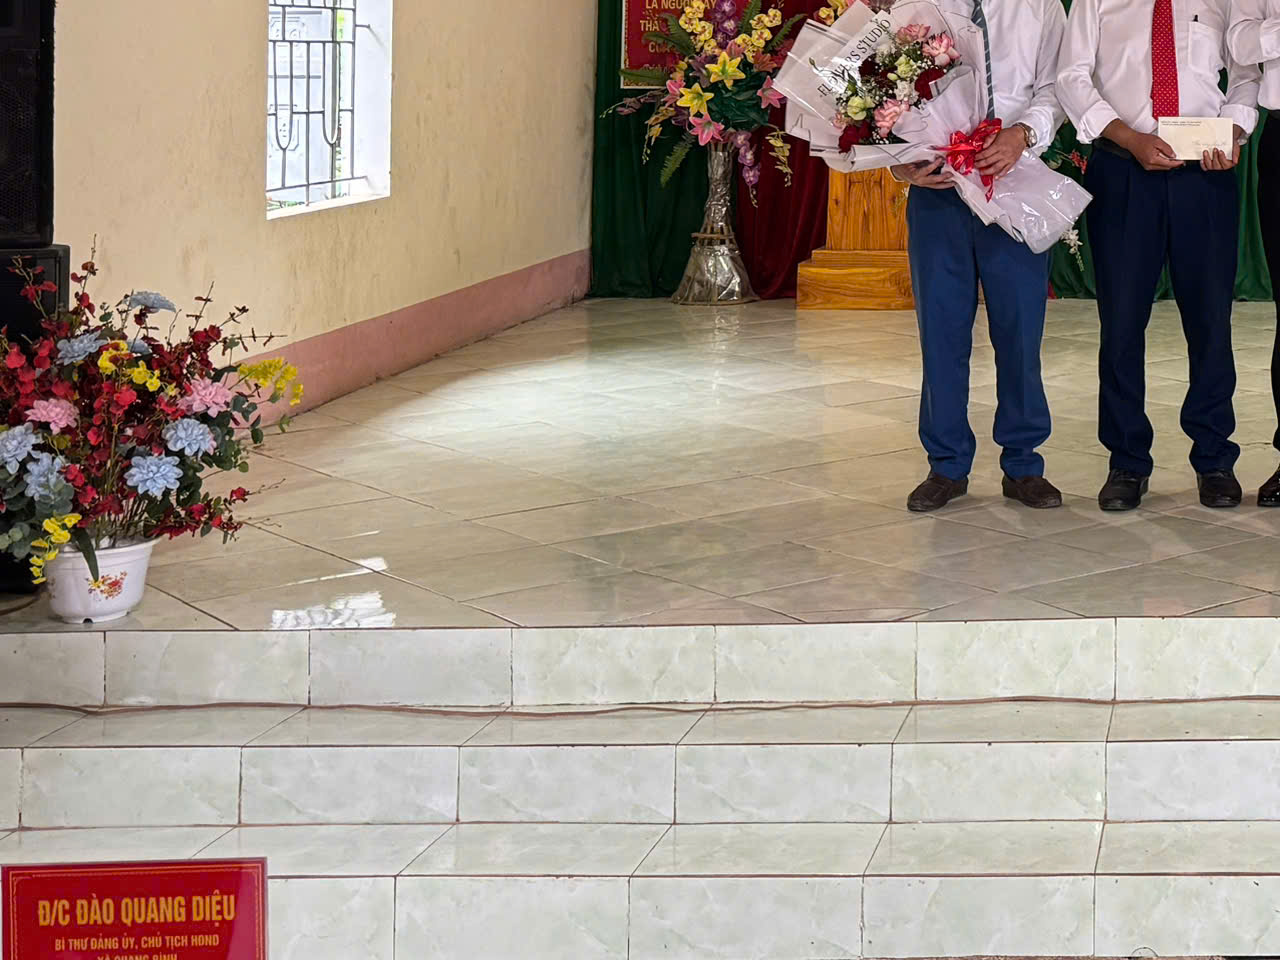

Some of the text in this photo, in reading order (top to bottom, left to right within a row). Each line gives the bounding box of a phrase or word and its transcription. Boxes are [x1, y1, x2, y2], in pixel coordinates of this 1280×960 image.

[857, 19, 891, 54] STUDIO
[38, 889, 236, 928] Đ/C ĐÀO QUANG DIỆU
[68, 937, 89, 951] THƯ
[90, 933, 119, 950] ĐẢNG
[141, 931, 162, 949] CHỦ
[165, 935, 188, 950] TỊCH
